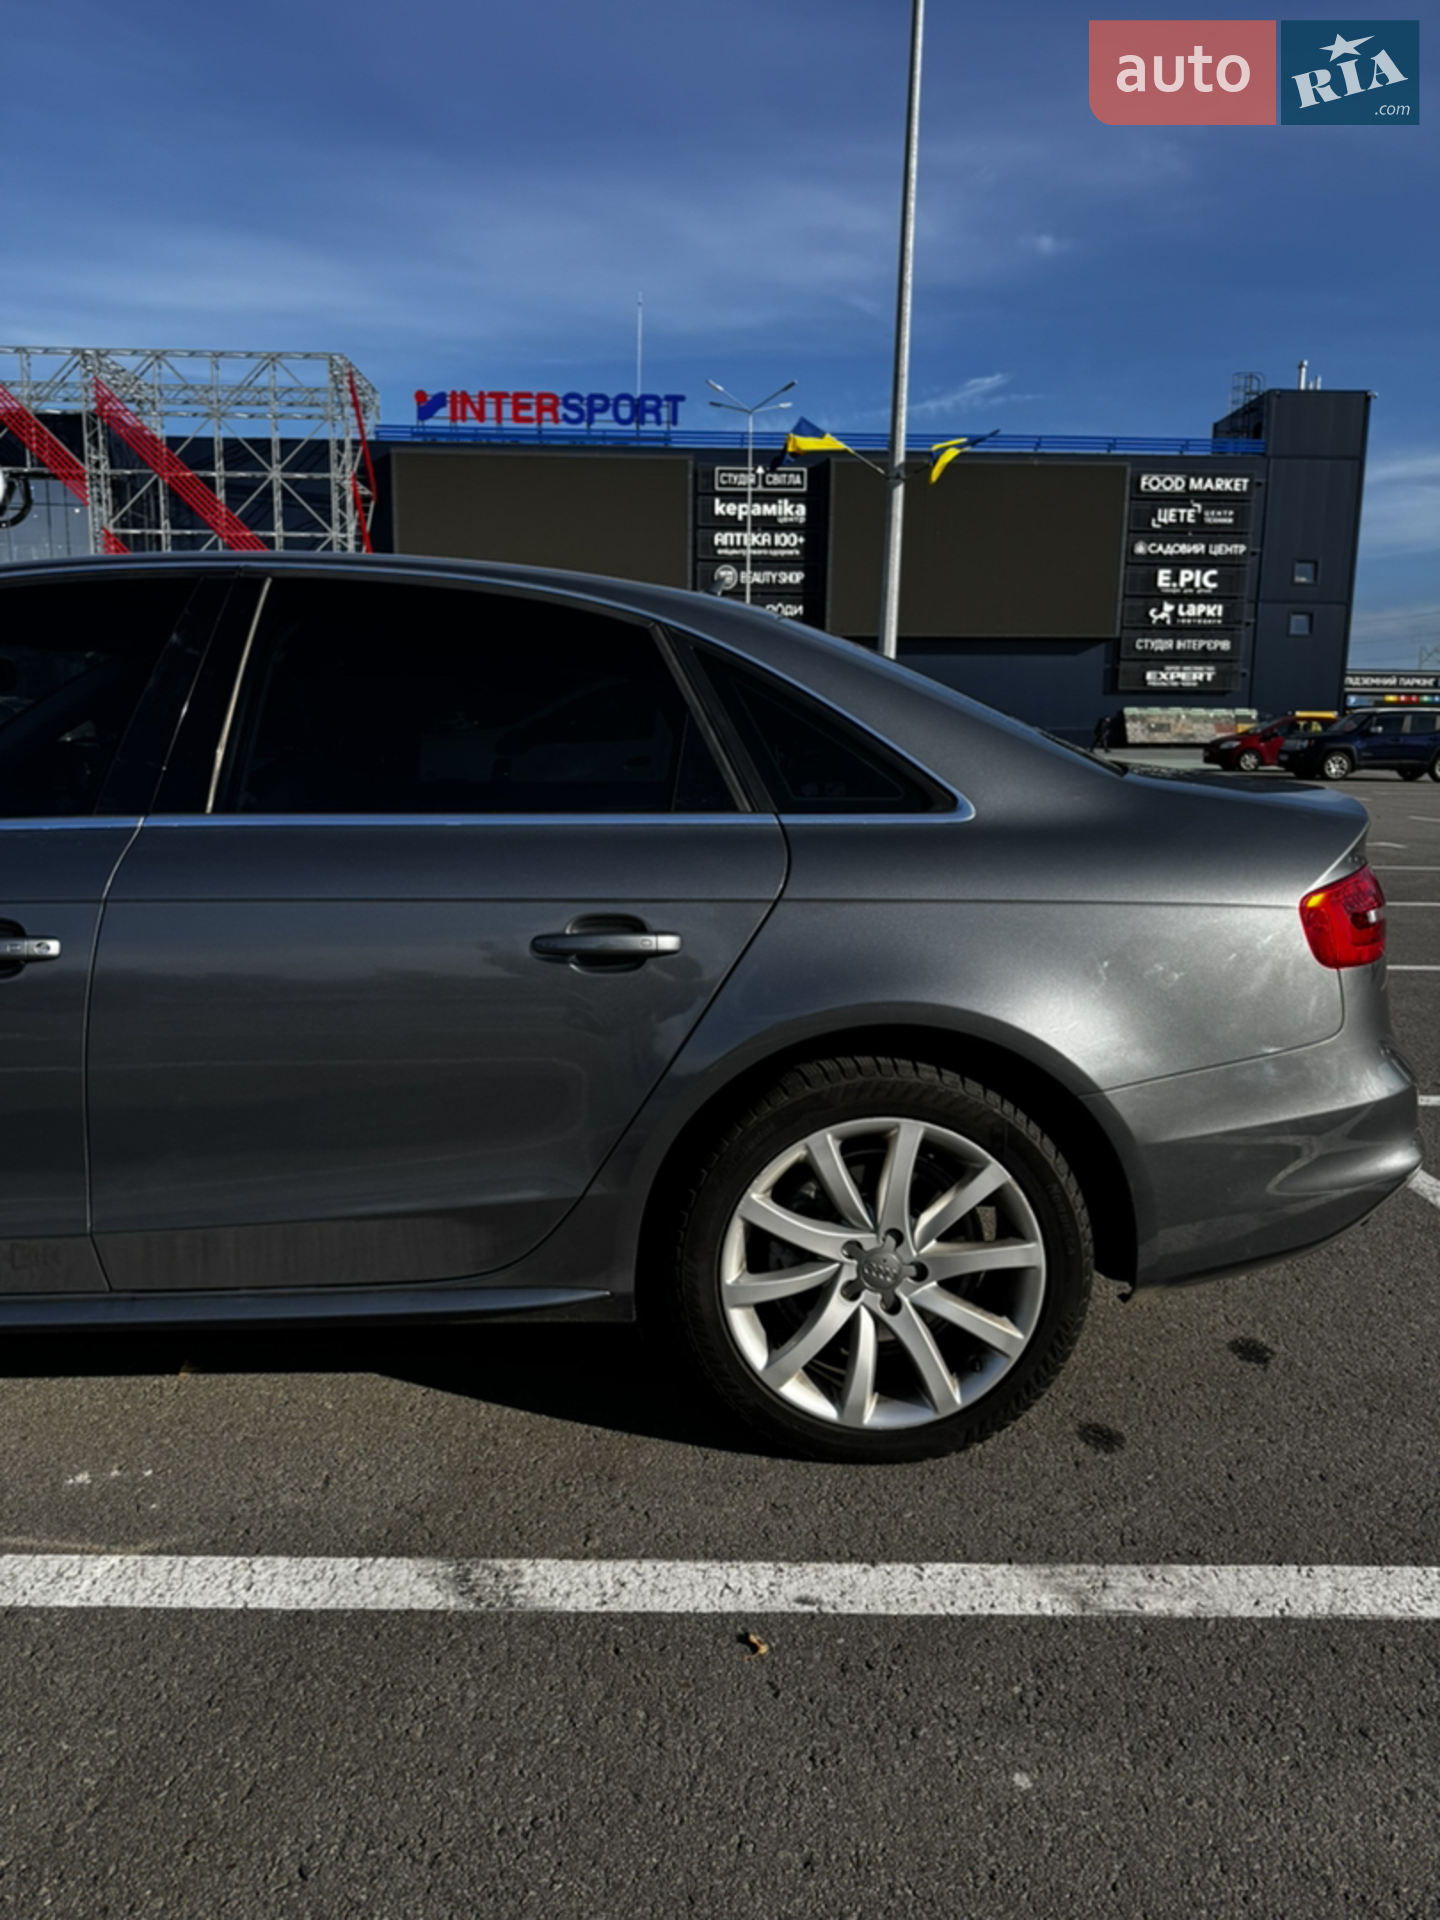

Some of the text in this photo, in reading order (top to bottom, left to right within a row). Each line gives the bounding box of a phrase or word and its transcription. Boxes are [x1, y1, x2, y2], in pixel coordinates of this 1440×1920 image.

[448, 390, 686, 426] INTERSPORT
[765, 473, 802, 486] СВІТЛА
[1140, 475, 1249, 492] FOOD MARKET
[1157, 508, 1196, 525] ЦЕТЕ
[1147, 542, 1247, 557] САДОВИЙ ЦЕНТР
[778, 571, 805, 584] SHOP
[1156, 569, 1218, 588] E.PIC
[1135, 638, 1174, 652] СТУДІЯ
[1145, 670, 1217, 682] EXPERT
